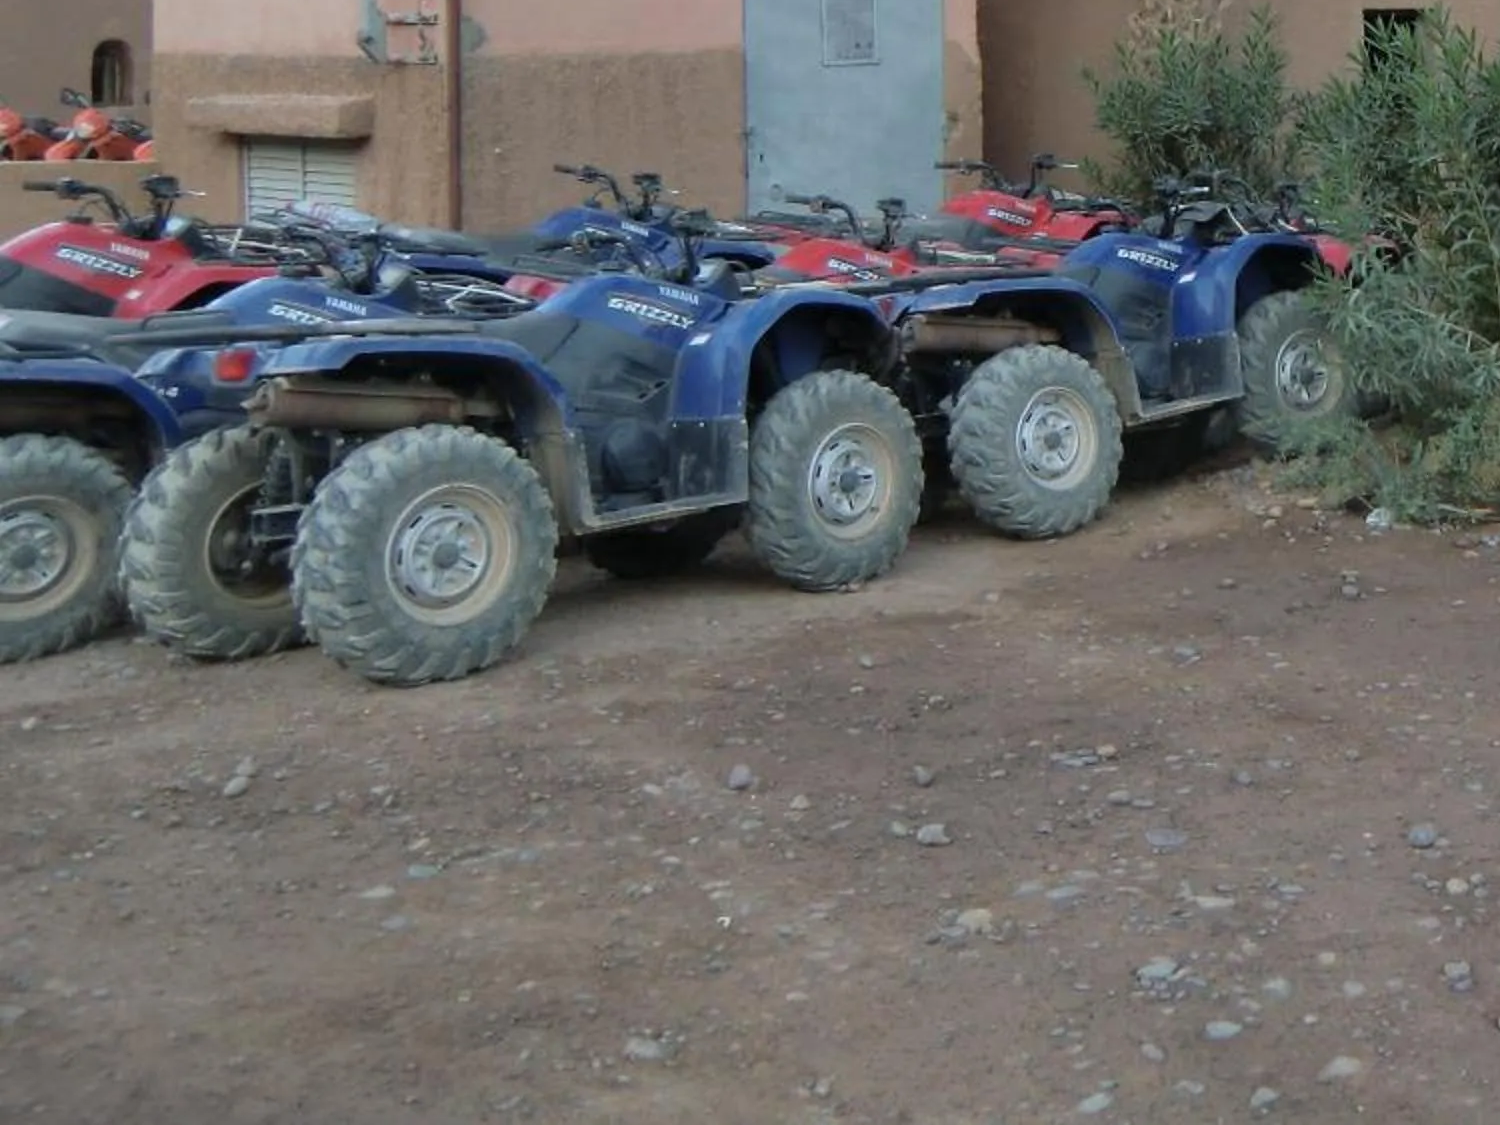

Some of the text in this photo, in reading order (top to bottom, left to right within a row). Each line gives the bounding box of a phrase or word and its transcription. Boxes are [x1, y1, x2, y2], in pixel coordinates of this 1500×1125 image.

[111, 242, 150, 260] YAMAHA
[1117, 249, 1180, 272] GRIZZLY
[56, 247, 143, 278] GRIZZLY
[325, 295, 367, 316] YAMAHA
[659, 286, 699, 306] YAMAHA
[607, 298, 695, 329] GRIZZLY
